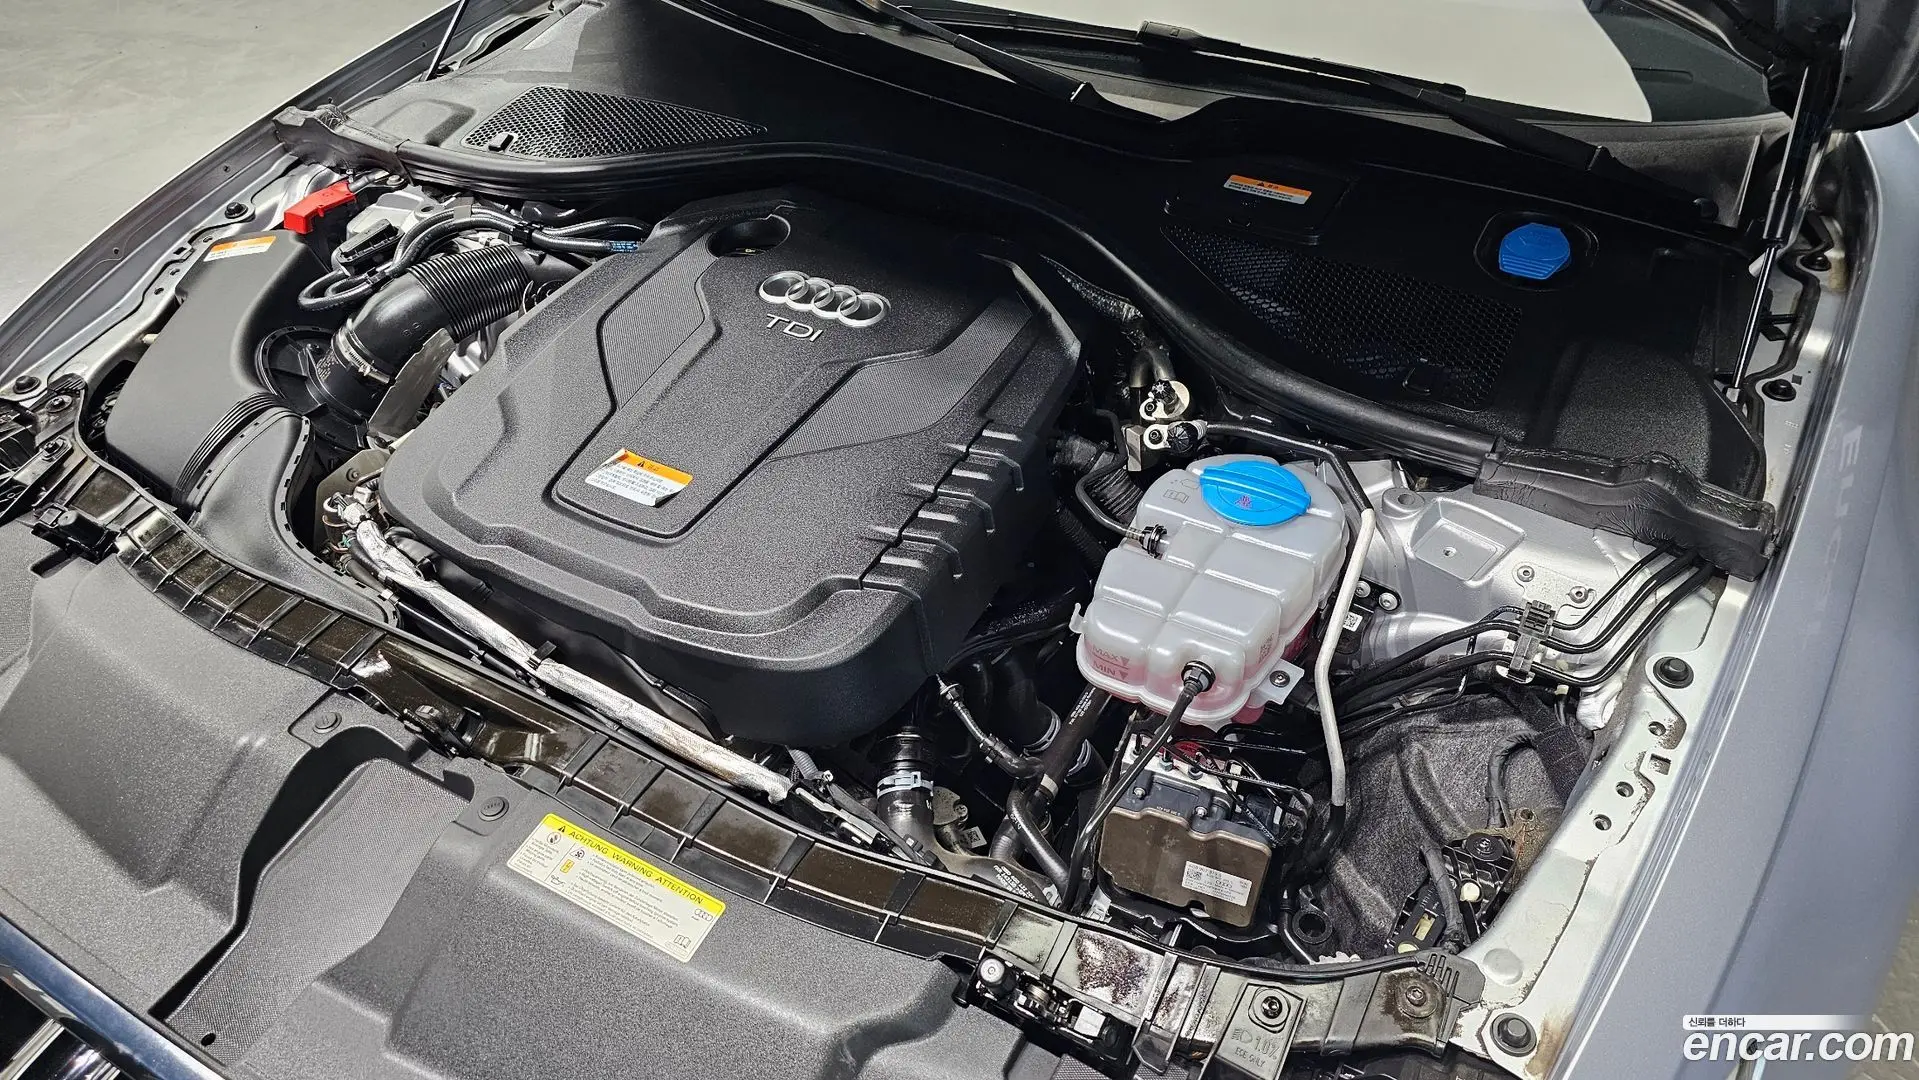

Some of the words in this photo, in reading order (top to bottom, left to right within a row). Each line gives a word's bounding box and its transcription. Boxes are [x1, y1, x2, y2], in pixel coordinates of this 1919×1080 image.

[766, 313, 824, 342] TDI
[1092, 644, 1119, 661] MAX
[1093, 660, 1116, 675] MIN
[568, 831, 609, 855] ACHTUNG
[612, 852, 653, 878] WARNING
[655, 874, 704, 904] ATTENTION
